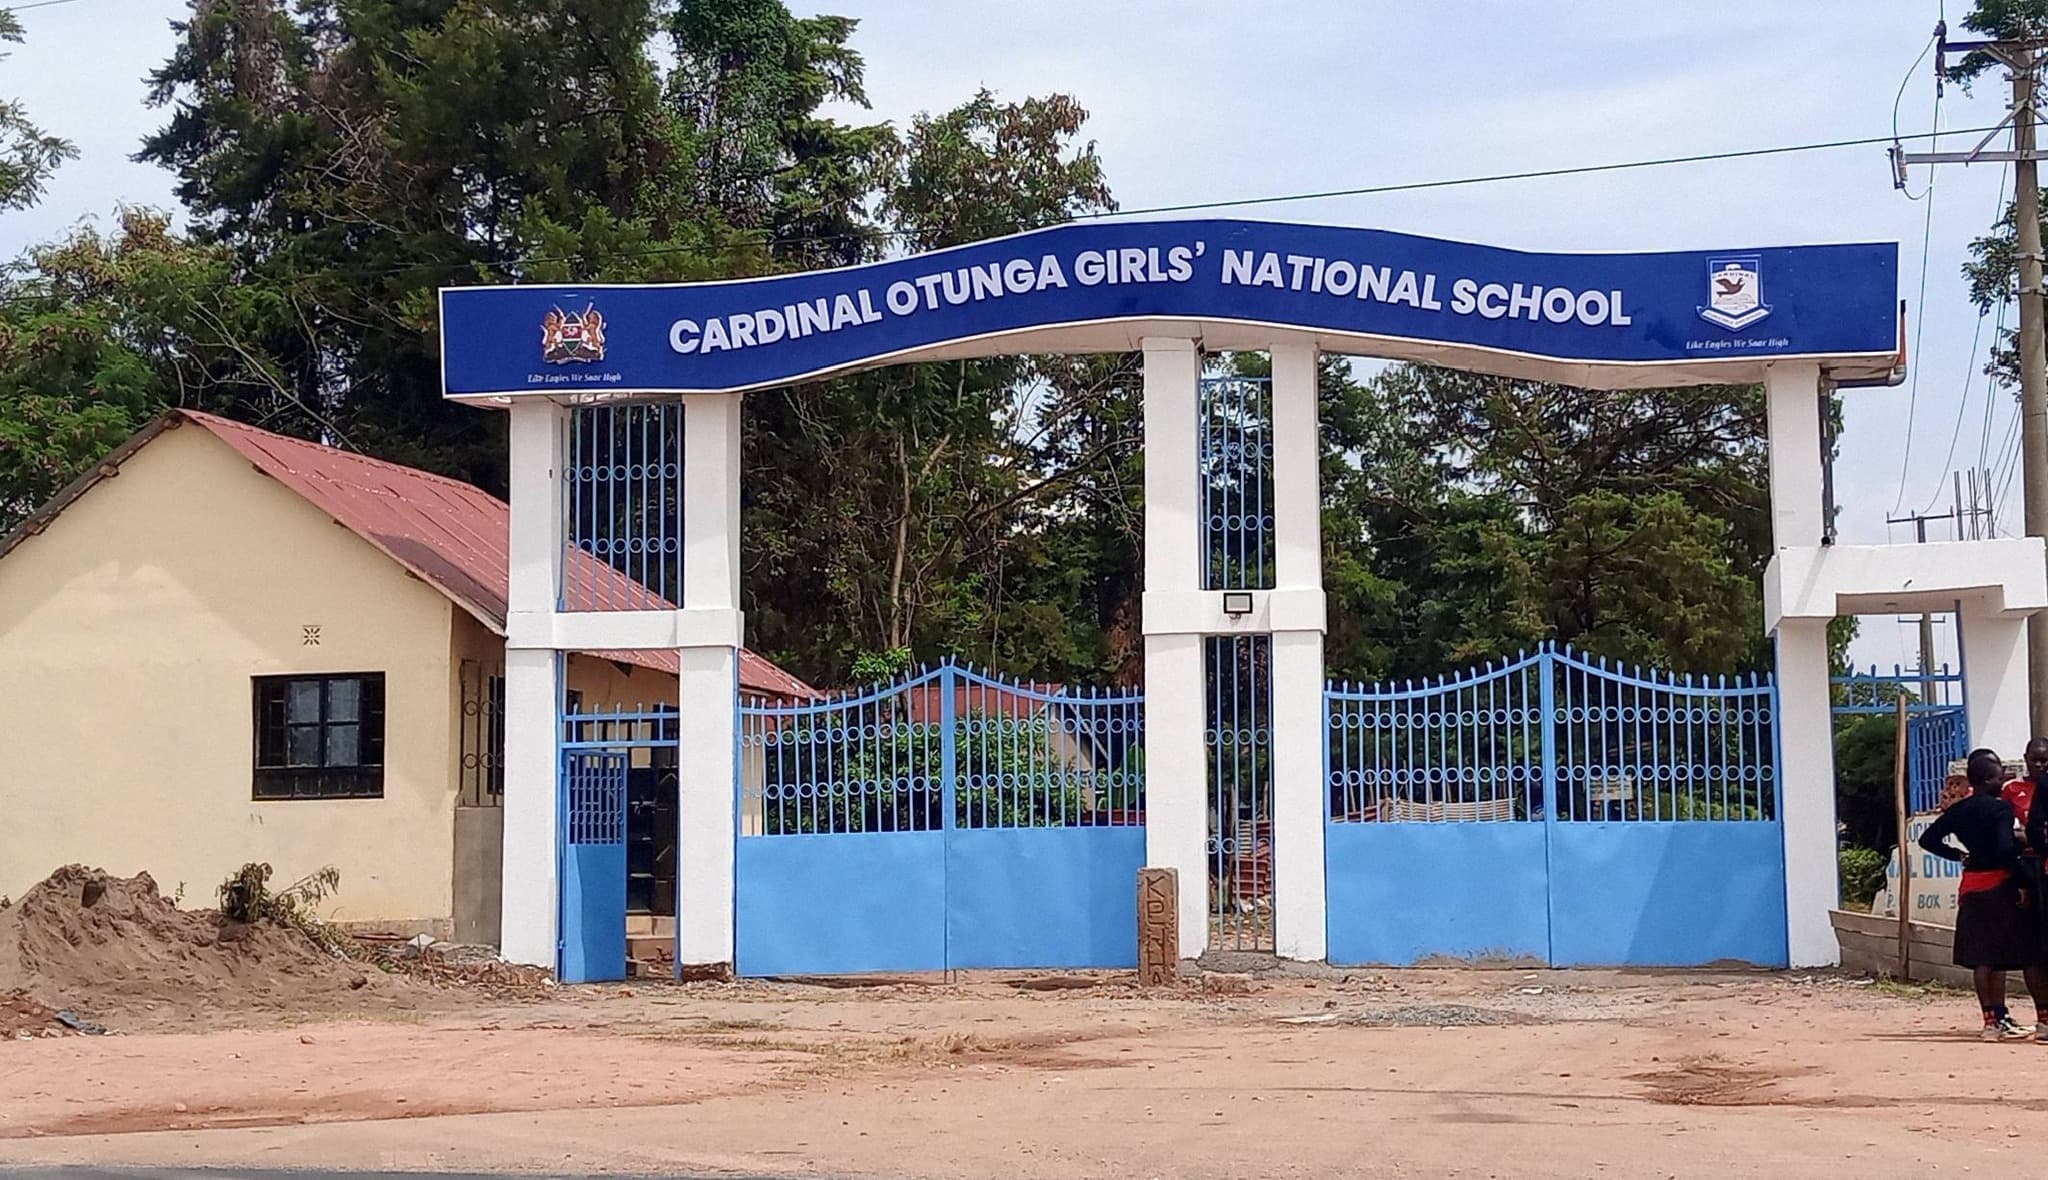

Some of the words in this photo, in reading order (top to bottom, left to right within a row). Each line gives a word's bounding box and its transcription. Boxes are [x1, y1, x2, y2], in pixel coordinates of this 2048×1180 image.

[669, 289, 883, 354] CARDINAL
[886, 255, 1068, 316] OTUNGA
[1074, 241, 1205, 286] GIRLS’
[1221, 249, 1442, 311] NATIONAL
[1451, 278, 1632, 327] SCHOOL
[1686, 340, 1704, 350] Like
[1704, 340, 1732, 350] Eagles
[1733, 339, 1747, 348] We
[1747, 338, 1768, 348] Soar
[1768, 338, 1789, 348] High
[602, 372, 622, 383] High
[1918, 894, 1941, 909] BOX
